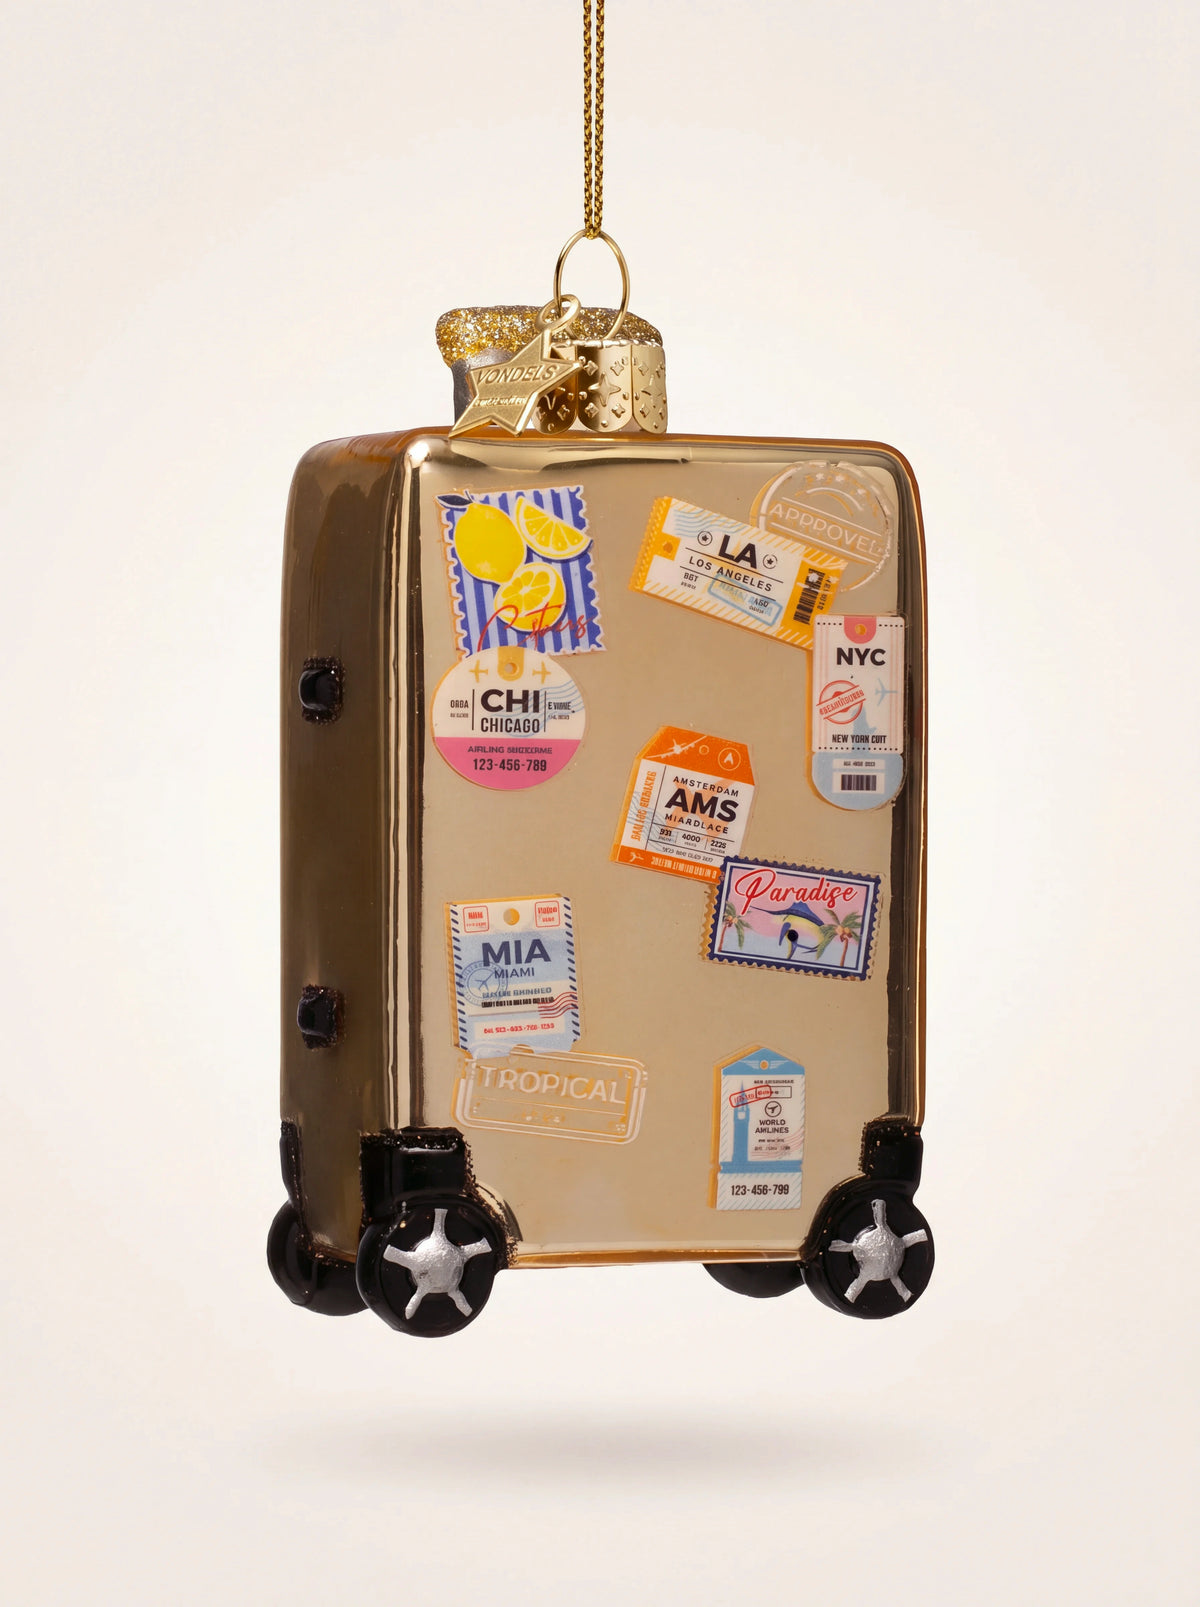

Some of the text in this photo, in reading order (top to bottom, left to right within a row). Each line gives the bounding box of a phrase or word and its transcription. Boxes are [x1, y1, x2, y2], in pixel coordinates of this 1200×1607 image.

[477, 364, 559, 385] VONDELS
[718, 534, 757, 569] LA
[689, 556, 712, 571] LOS
[717, 566, 773, 592] ANGELES
[836, 647, 886, 666] NYC
[481, 689, 540, 713] CHI
[481, 717, 540, 733] CHICAGO
[832, 734, 849, 743] NEW
[473, 758, 547, 771] 123-456-789
[672, 776, 739, 797] AMSTERDAM
[664, 788, 739, 823] AMS
[682, 833, 701, 843] 4000
[734, 868, 858, 916] Paradise
[482, 938, 551, 967] MIA
[494, 967, 535, 979] MIAMI
[480, 1065, 626, 1104] TROPICAL
